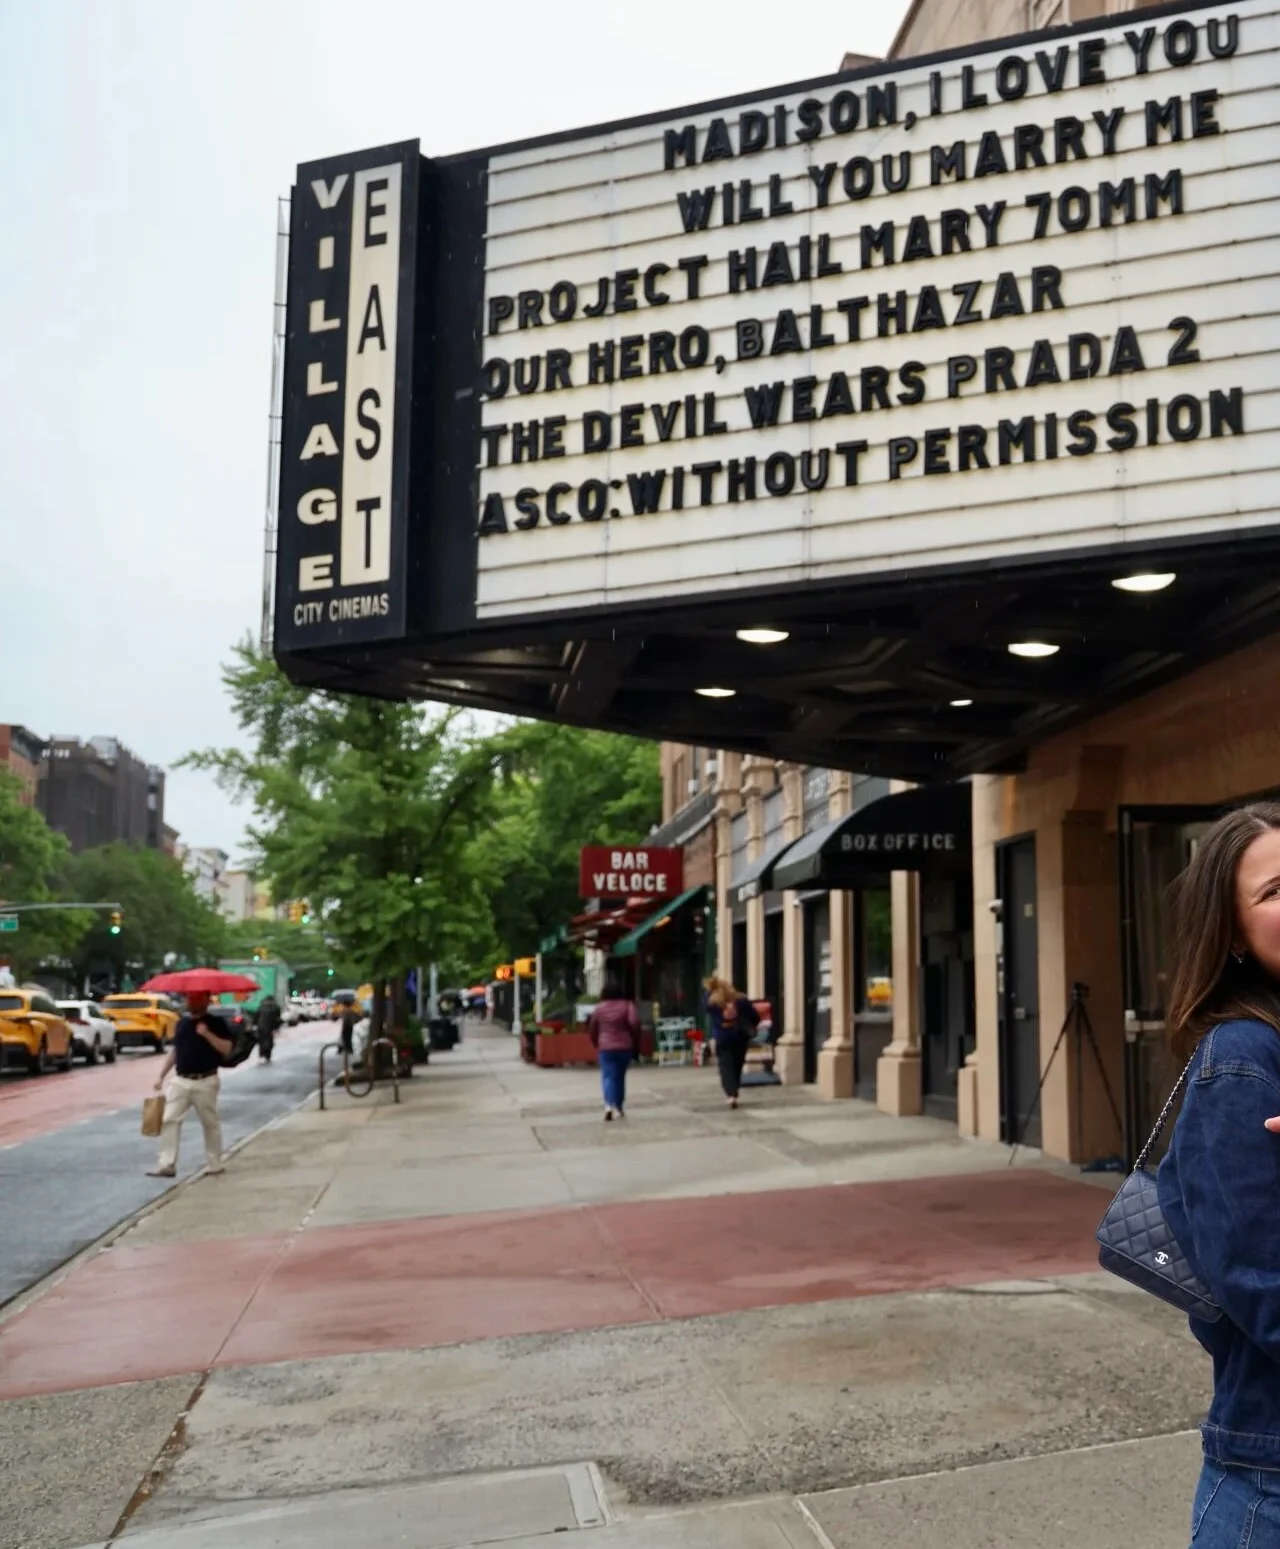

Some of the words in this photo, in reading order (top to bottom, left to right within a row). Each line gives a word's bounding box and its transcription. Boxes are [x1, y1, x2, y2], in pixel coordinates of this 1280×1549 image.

[664, 81, 918, 171] MADISON,
[962, 38, 1108, 111] LOVE
[1123, 14, 1240, 76] YOU
[677, 174, 796, 234] WILL
[808, 151, 912, 210] YOU
[930, 107, 1126, 187] MARRY
[1144, 89, 1224, 148] ME
[488, 255, 709, 337] PROJECT
[728, 233, 843, 294] HAIL
[860, 200, 1007, 270] MARY
[1025, 169, 1185, 240] 70MM
[297, 173, 350, 591] VILLAGE
[355, 176, 391, 570] EAST
[479, 348, 573, 400] OUR
[480, 415, 568, 467] THE
[582, 392, 728, 455] DEVIL
[744, 361, 927, 430] WEARS
[947, 326, 1146, 400] PRADA
[1167, 317, 1202, 367] 2
[888, 387, 1245, 481] PERMISSION
[294, 601, 324, 626] CITY
[328, 593, 389, 622] CINEMAS
[592, 872, 667, 892] VELOCE
[611, 851, 649, 870] BAR
[841, 833, 878, 850] BOX
[883, 833, 956, 850] OFFICE
